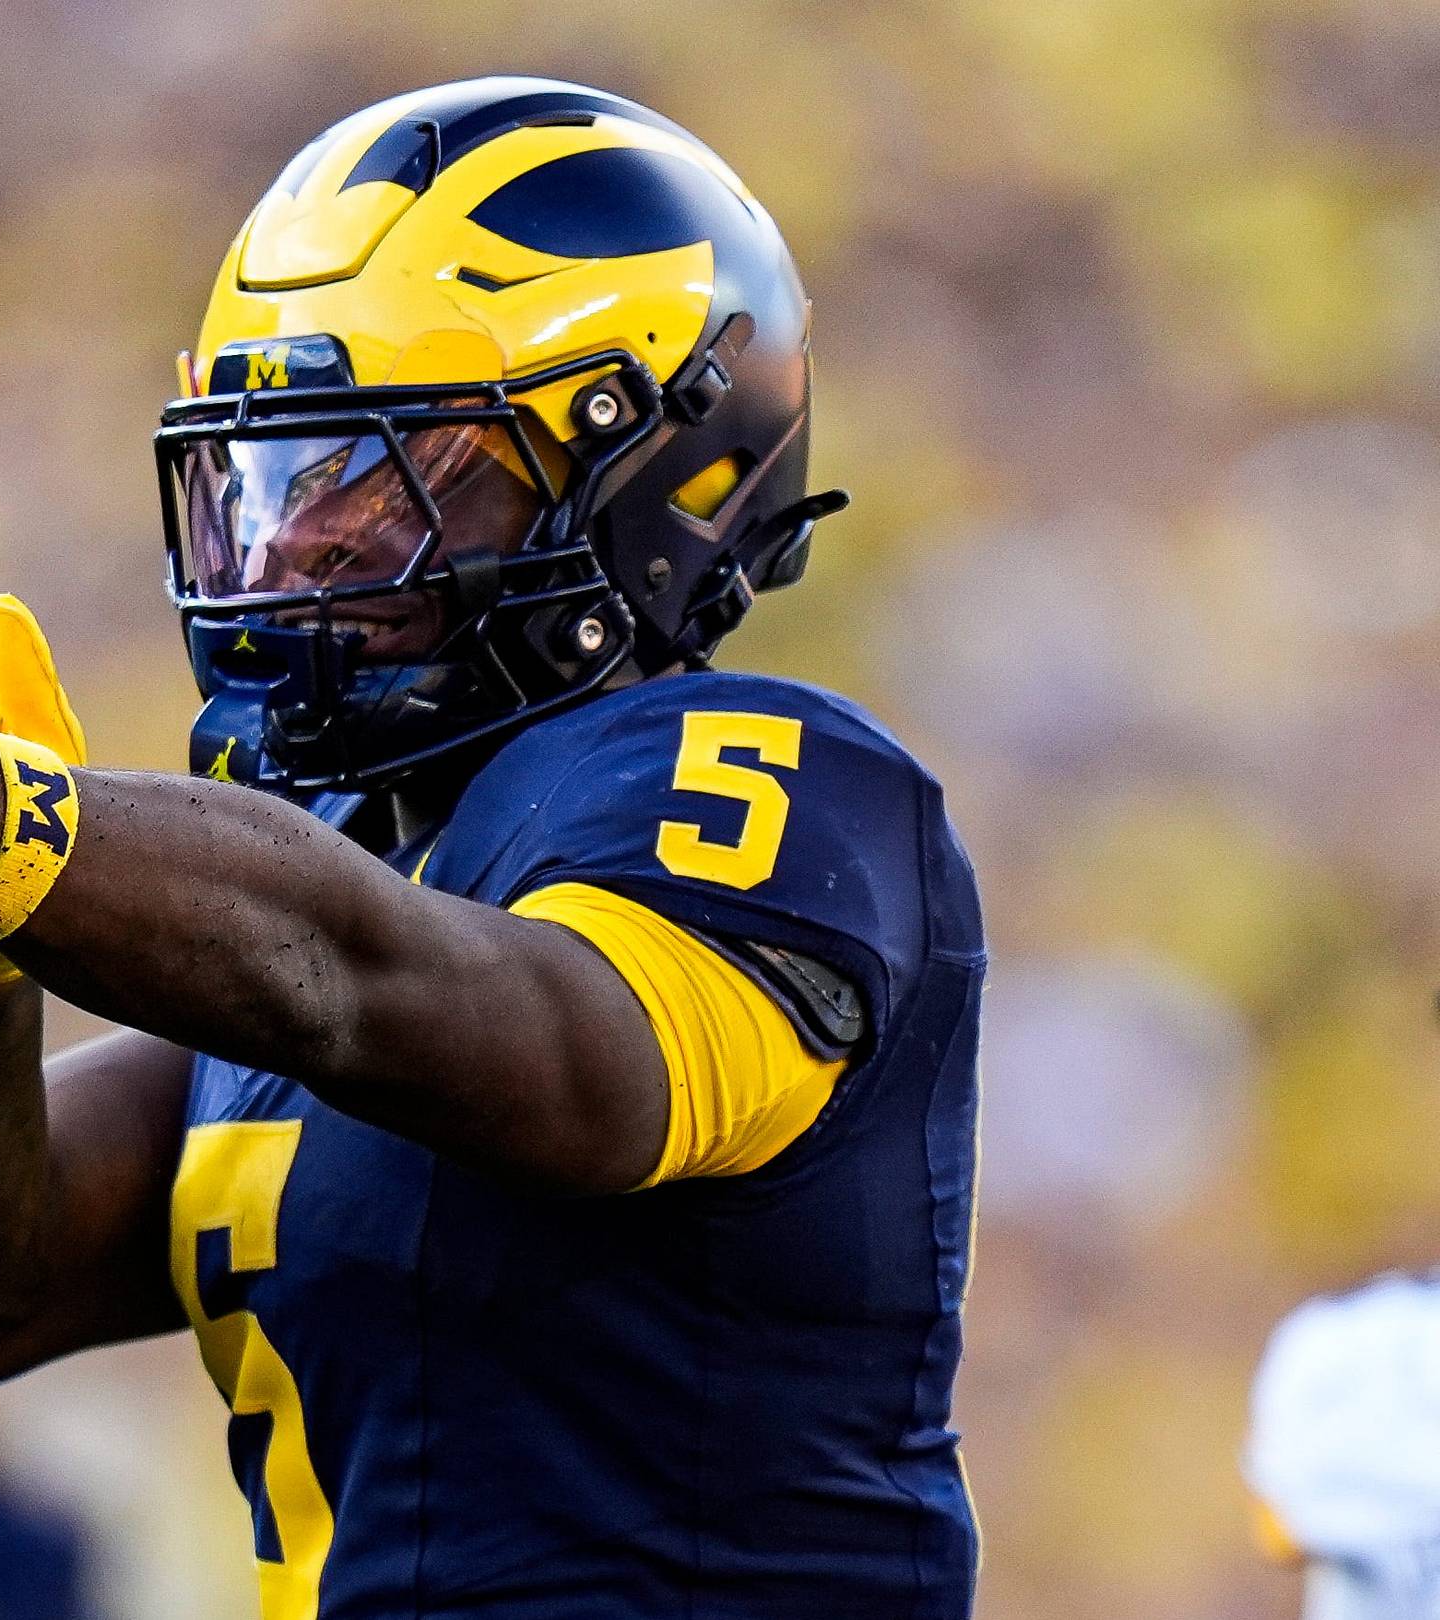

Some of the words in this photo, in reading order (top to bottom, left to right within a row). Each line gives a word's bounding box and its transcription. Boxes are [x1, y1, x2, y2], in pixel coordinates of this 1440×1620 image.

[245, 344, 291, 390] M
[14, 759, 71, 858] M
[656, 710, 803, 891] 5
[170, 1119, 335, 1620] 5
